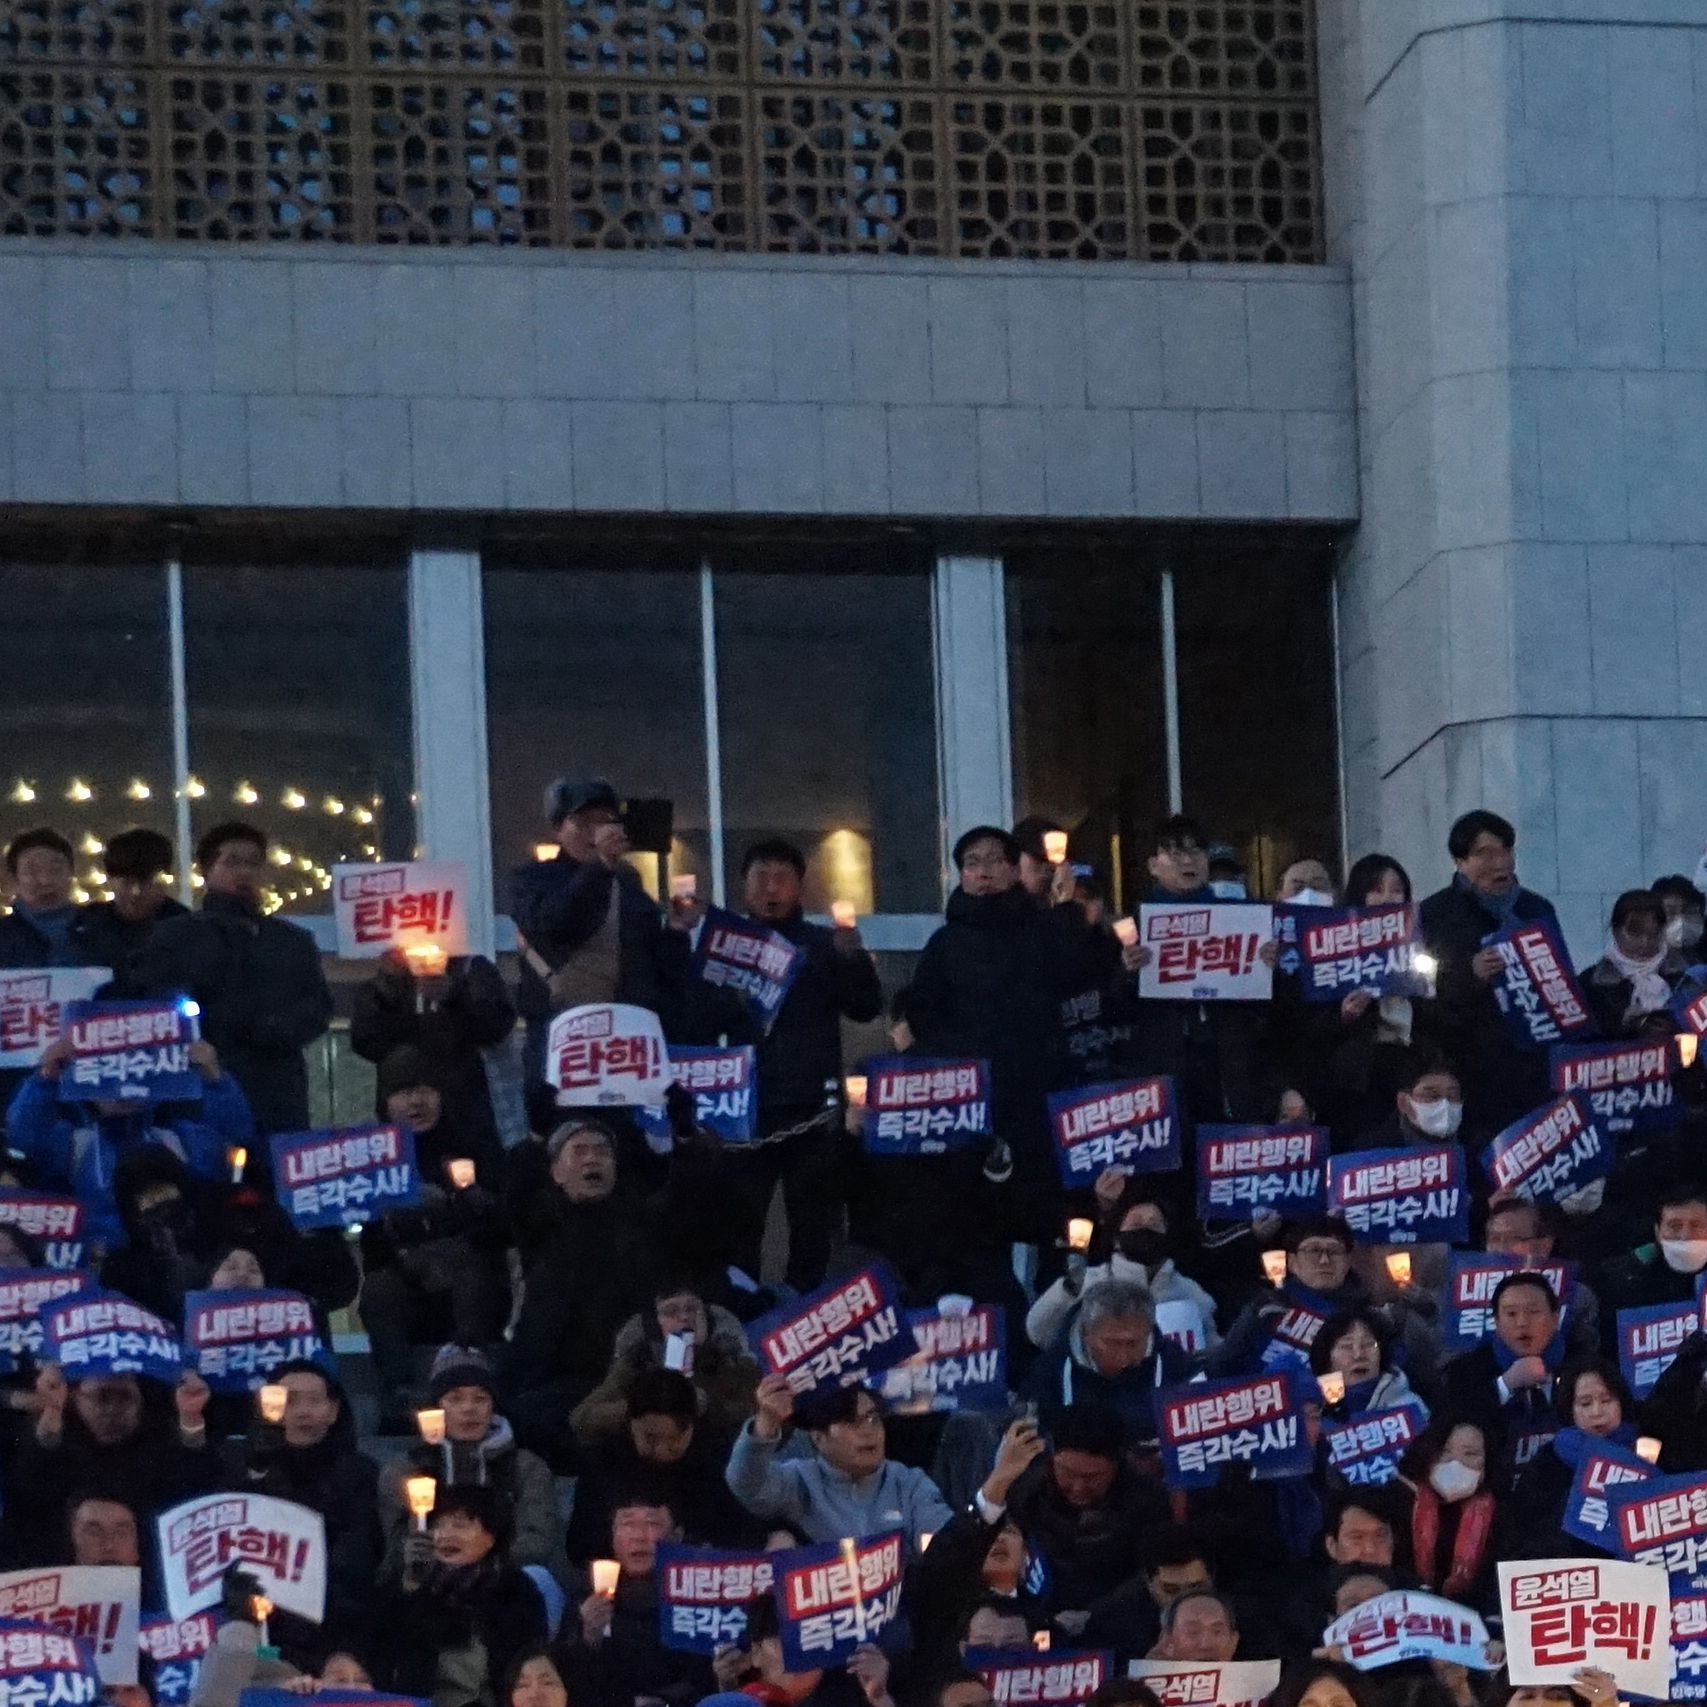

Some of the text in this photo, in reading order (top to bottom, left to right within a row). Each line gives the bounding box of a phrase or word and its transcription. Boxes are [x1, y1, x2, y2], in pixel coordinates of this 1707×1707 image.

[354, 893, 451, 942] 탄핵!
[1309, 914, 1406, 958] 내란행위
[1159, 933, 1256, 983] 탄핵!
[559, 1040, 664, 1082] 탄핵!
[879, 1066, 978, 1104] 내란행위
[876, 1108, 986, 1139] 즉각수사!
[1062, 1086, 1161, 1138] 내란행위
[290, 1135, 397, 1181] 내란행위
[1068, 1127, 1170, 1171] 즉각수사!
[1209, 1136, 1314, 1171] 내란행위
[1493, 1097, 1579, 1193] 내란행위
[1209, 1171, 1320, 1202] 즉각수사!
[1342, 1158, 1449, 1200] 내란행위
[1344, 1196, 1459, 1230] 즉각수사!
[771, 1279, 875, 1364] 내란행위
[1171, 1386, 1285, 1442] 내란행위
[1176, 1420, 1297, 1473] 즉각수사!
[1514, 1572, 1596, 1604] 윤석열
[1531, 1603, 1656, 1662] 탄핵!
